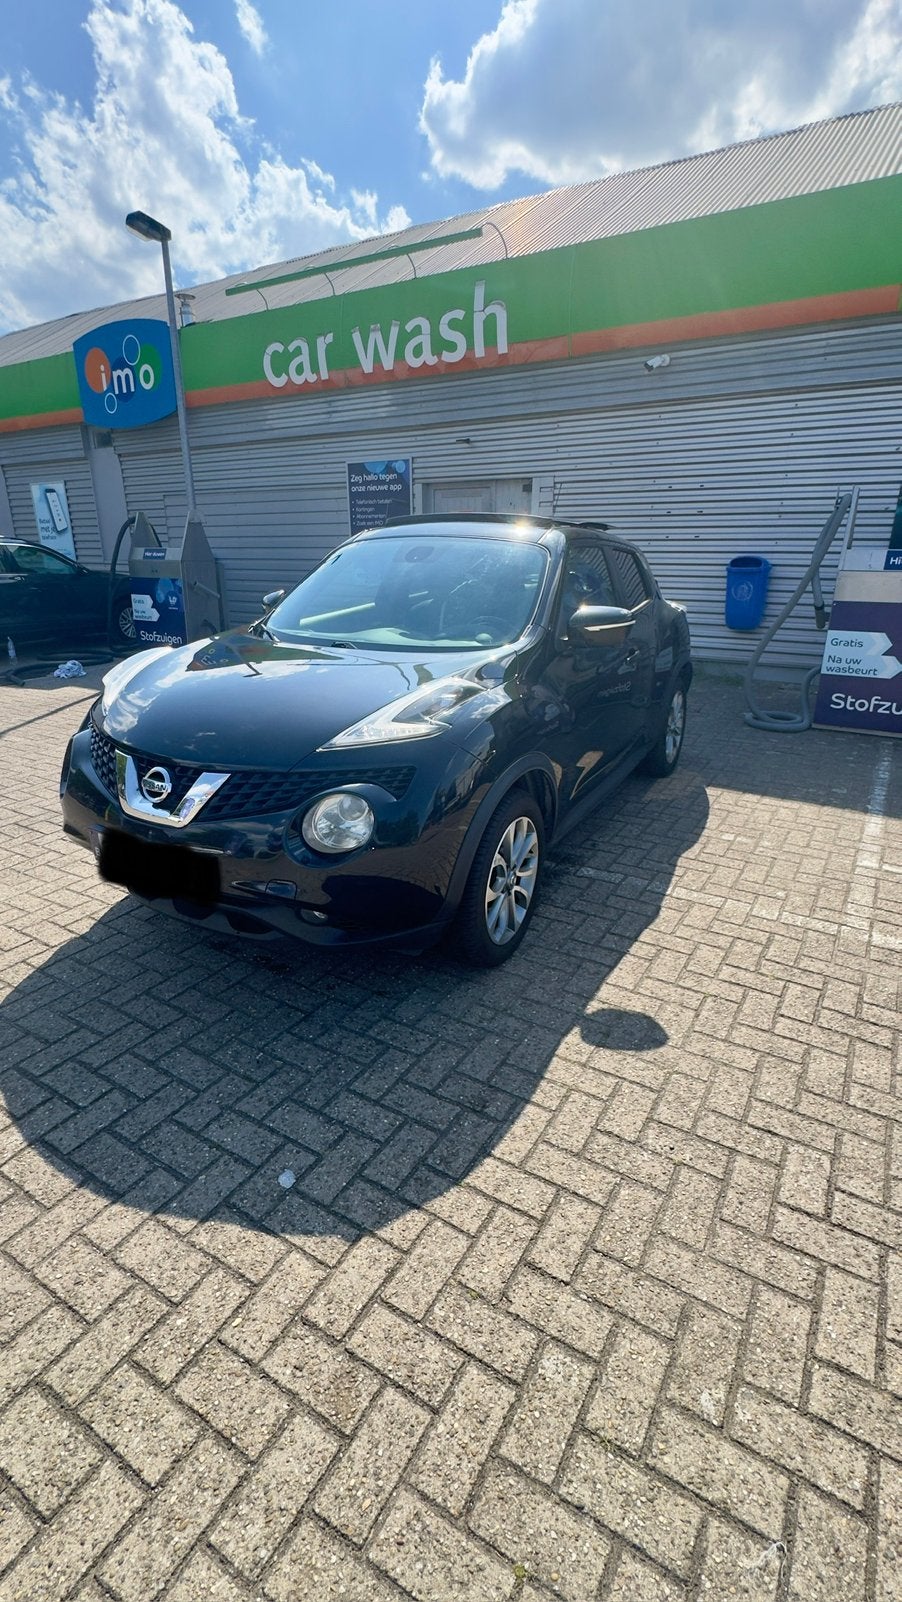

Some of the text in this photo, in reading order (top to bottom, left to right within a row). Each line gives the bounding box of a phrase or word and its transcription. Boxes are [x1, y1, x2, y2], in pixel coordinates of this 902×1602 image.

[263, 280, 508, 388] car wash
[100, 364, 154, 395] imo
[350, 473, 398, 483] Zeg hallo tegen
[140, 630, 183, 645] Stofzuigen
[830, 637, 864, 649] Gratis
[827, 655, 862, 666] Na uw
[826, 665, 878, 676] wasbeurt
